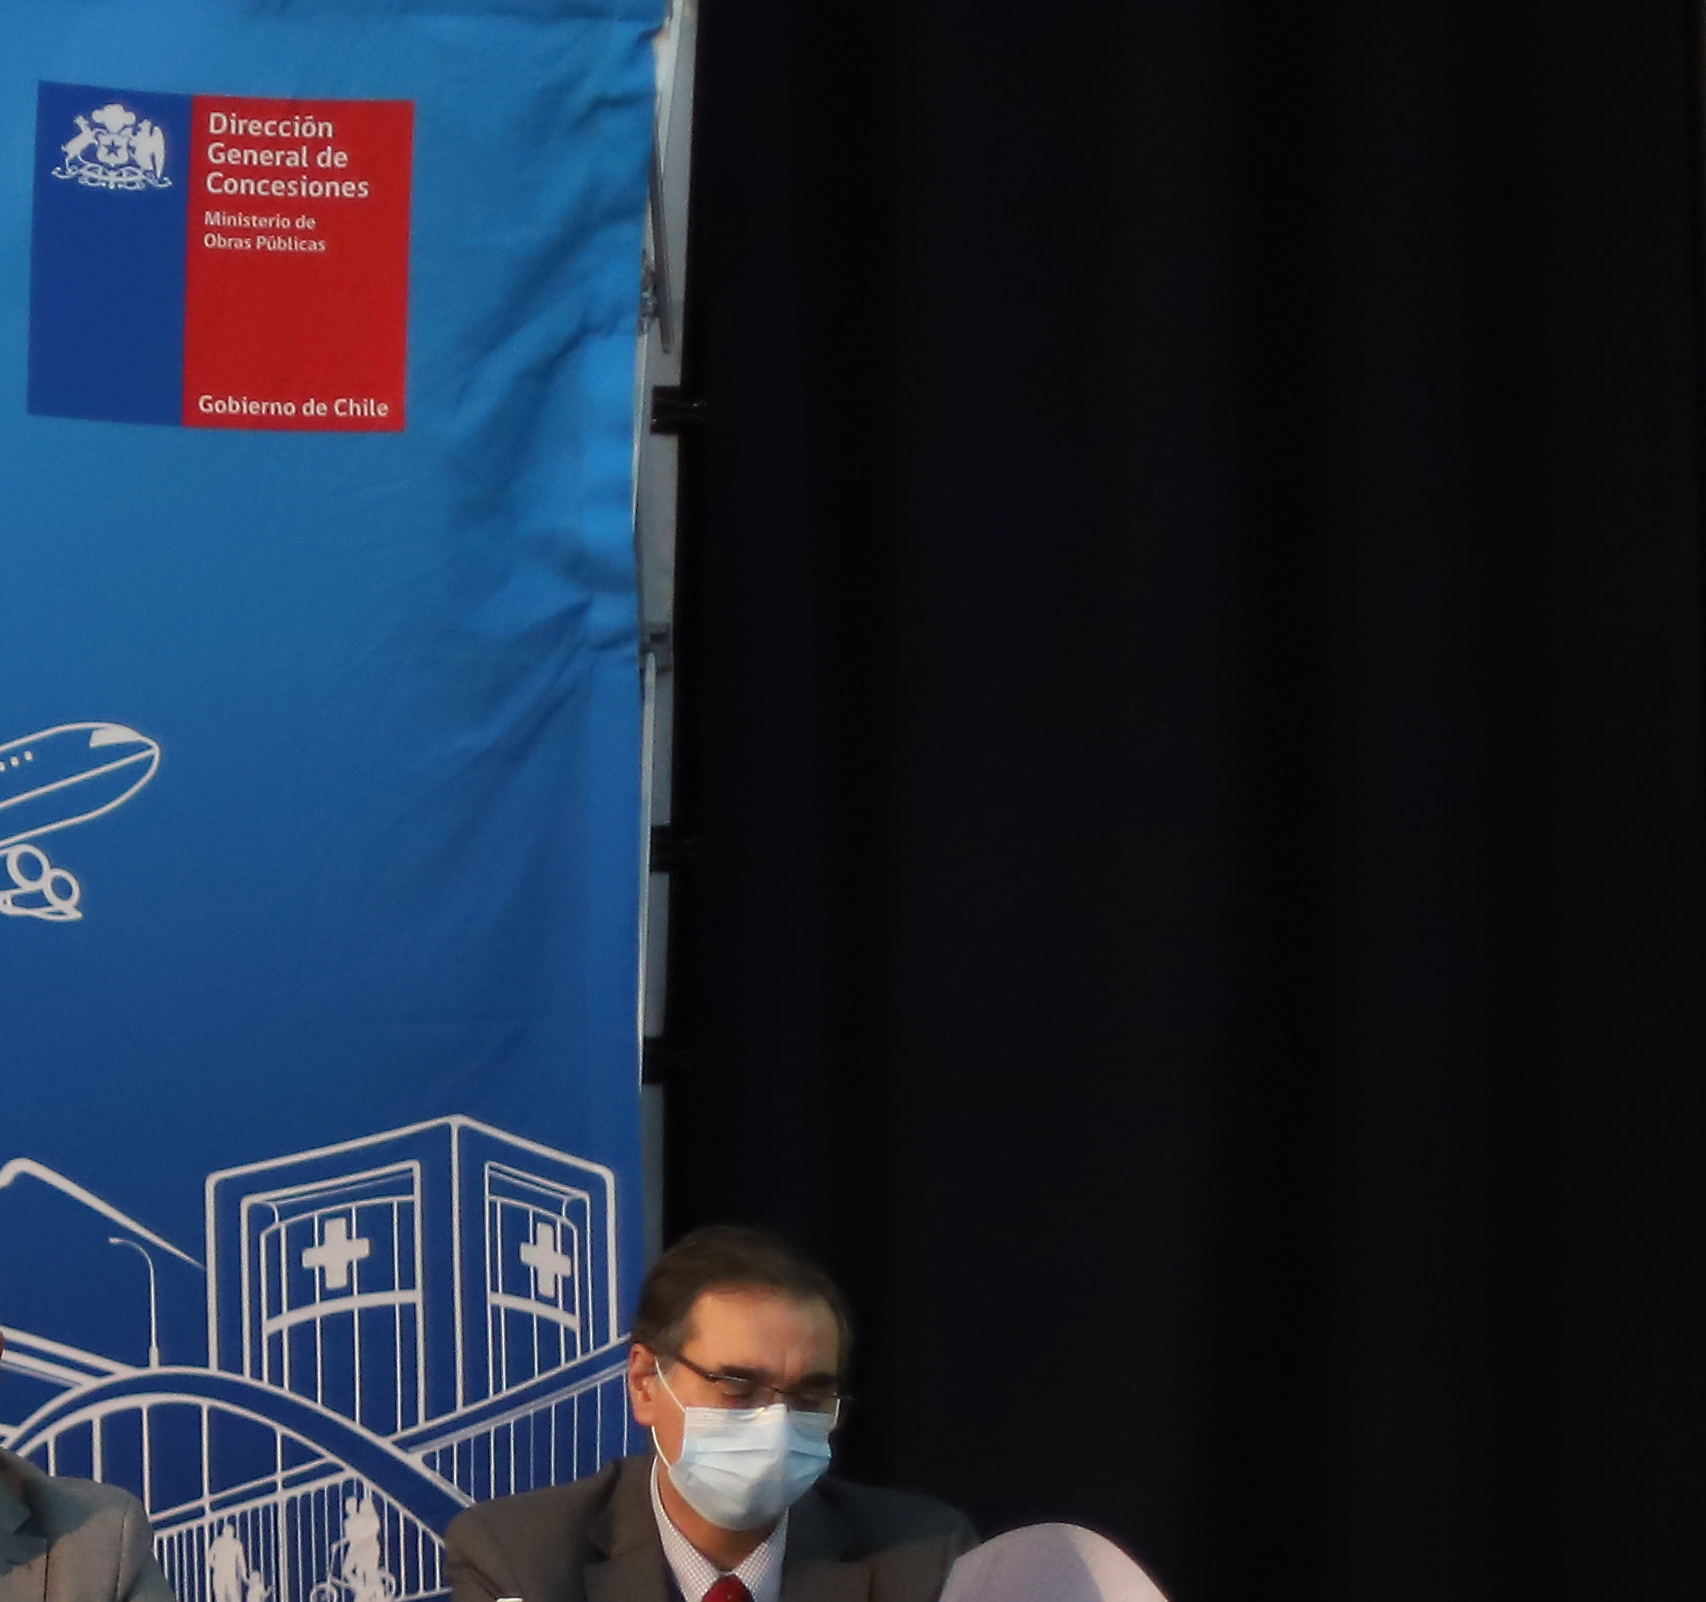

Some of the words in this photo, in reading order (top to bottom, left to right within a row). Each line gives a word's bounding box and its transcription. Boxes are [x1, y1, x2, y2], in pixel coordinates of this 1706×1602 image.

[209, 111, 333, 138] Dirección
[207, 141, 309, 168] General
[316, 145, 349, 168] de
[206, 171, 369, 198] Concesiones
[204, 210, 291, 229] Ministerio
[295, 214, 316, 230] de
[203, 232, 252, 250] Obras
[256, 235, 326, 252] Públicas
[198, 394, 297, 417] Gobierno
[301, 398, 328, 417] de
[333, 397, 389, 417] Chile
